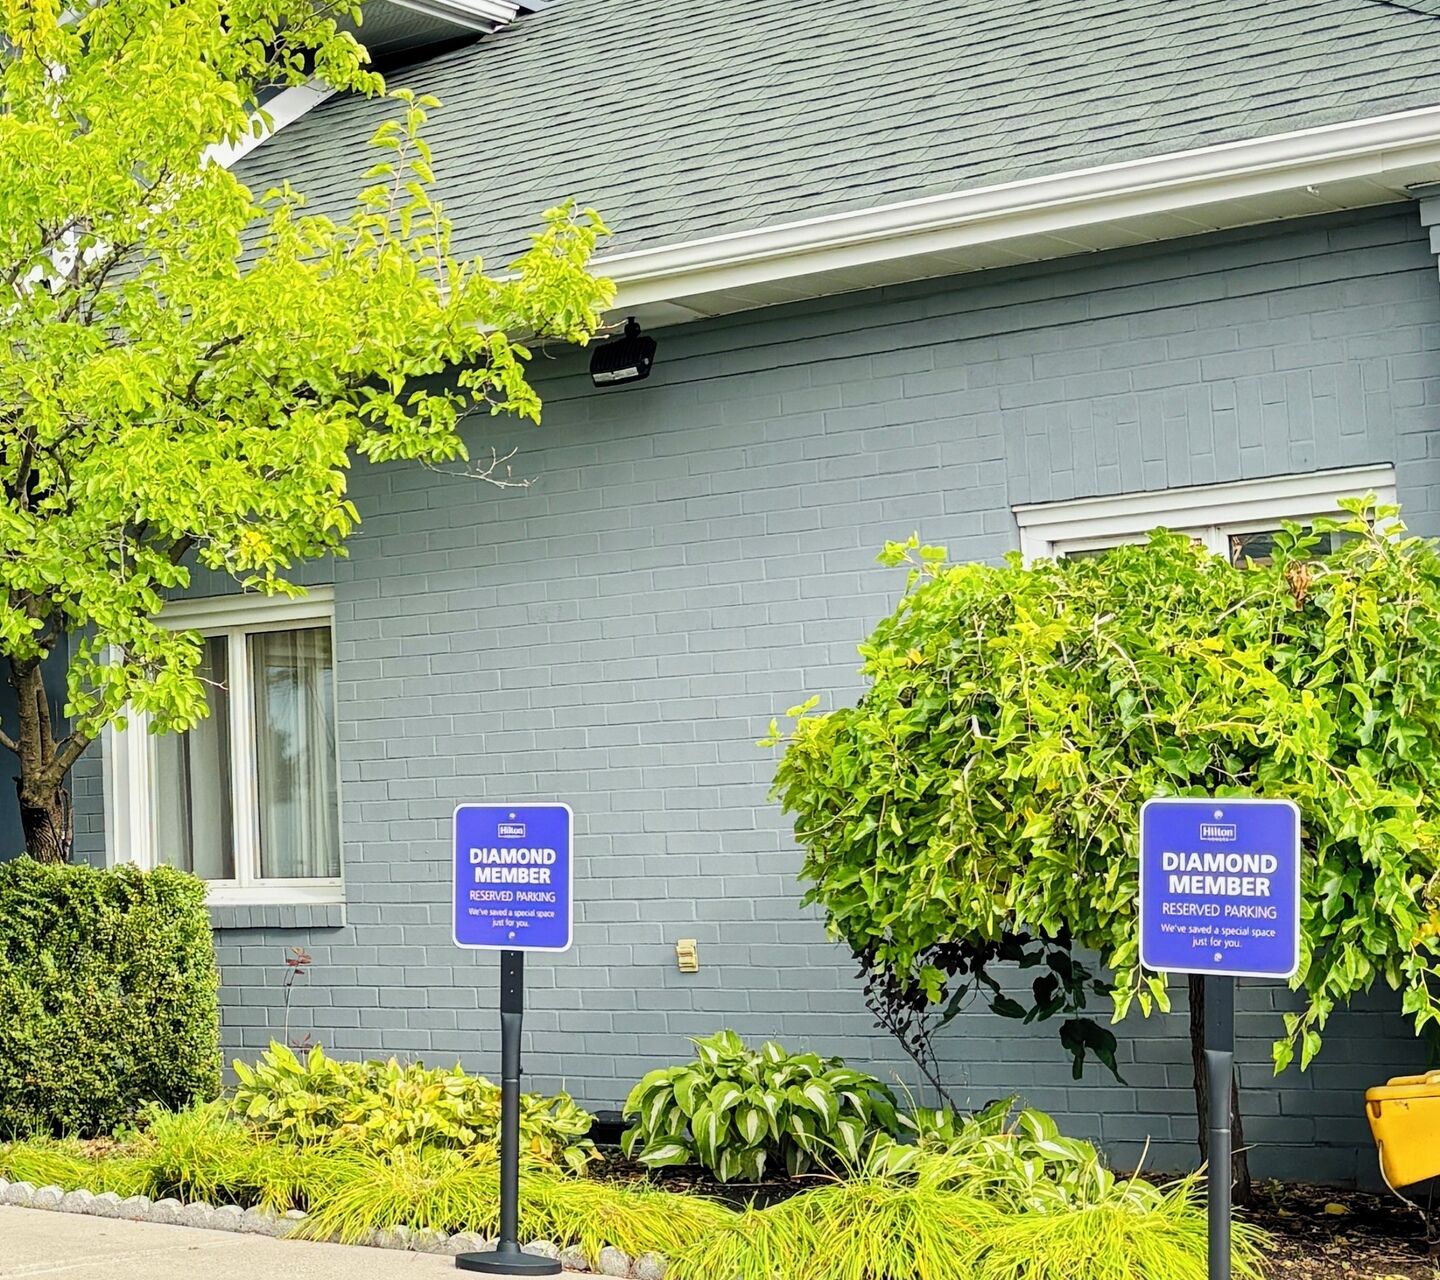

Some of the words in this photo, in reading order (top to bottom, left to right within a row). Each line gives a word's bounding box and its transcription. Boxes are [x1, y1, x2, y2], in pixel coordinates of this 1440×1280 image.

[500, 826, 524, 835] Hilton
[1203, 826, 1233, 837] Hilton
[469, 848, 557, 865] DIAMOND
[1162, 852, 1278, 874] DIAMOND
[474, 867, 551, 884] MEMBER
[1168, 875, 1270, 897] MEMBER
[469, 890, 513, 901] RESERVED
[516, 891, 556, 903] PARKING
[468, 907, 488, 916] We've
[489, 908, 507, 917] saved
[514, 908, 535, 918] special
[536, 910, 555, 919] space
[1162, 902, 1220, 917] RESERVED
[1225, 904, 1277, 919] PARKING
[492, 918, 504, 928] just
[505, 918, 515, 927] for
[516, 920, 530, 929] you.
[1160, 923, 1186, 934] We've
[1188, 924, 1212, 935] saved
[1213, 927, 1219, 935] a
[1220, 925, 1250, 937] special
[1251, 927, 1276, 938] space
[1192, 936, 1208, 948] just
[1210, 936, 1221, 947] for
[1223, 938, 1242, 949] you.
